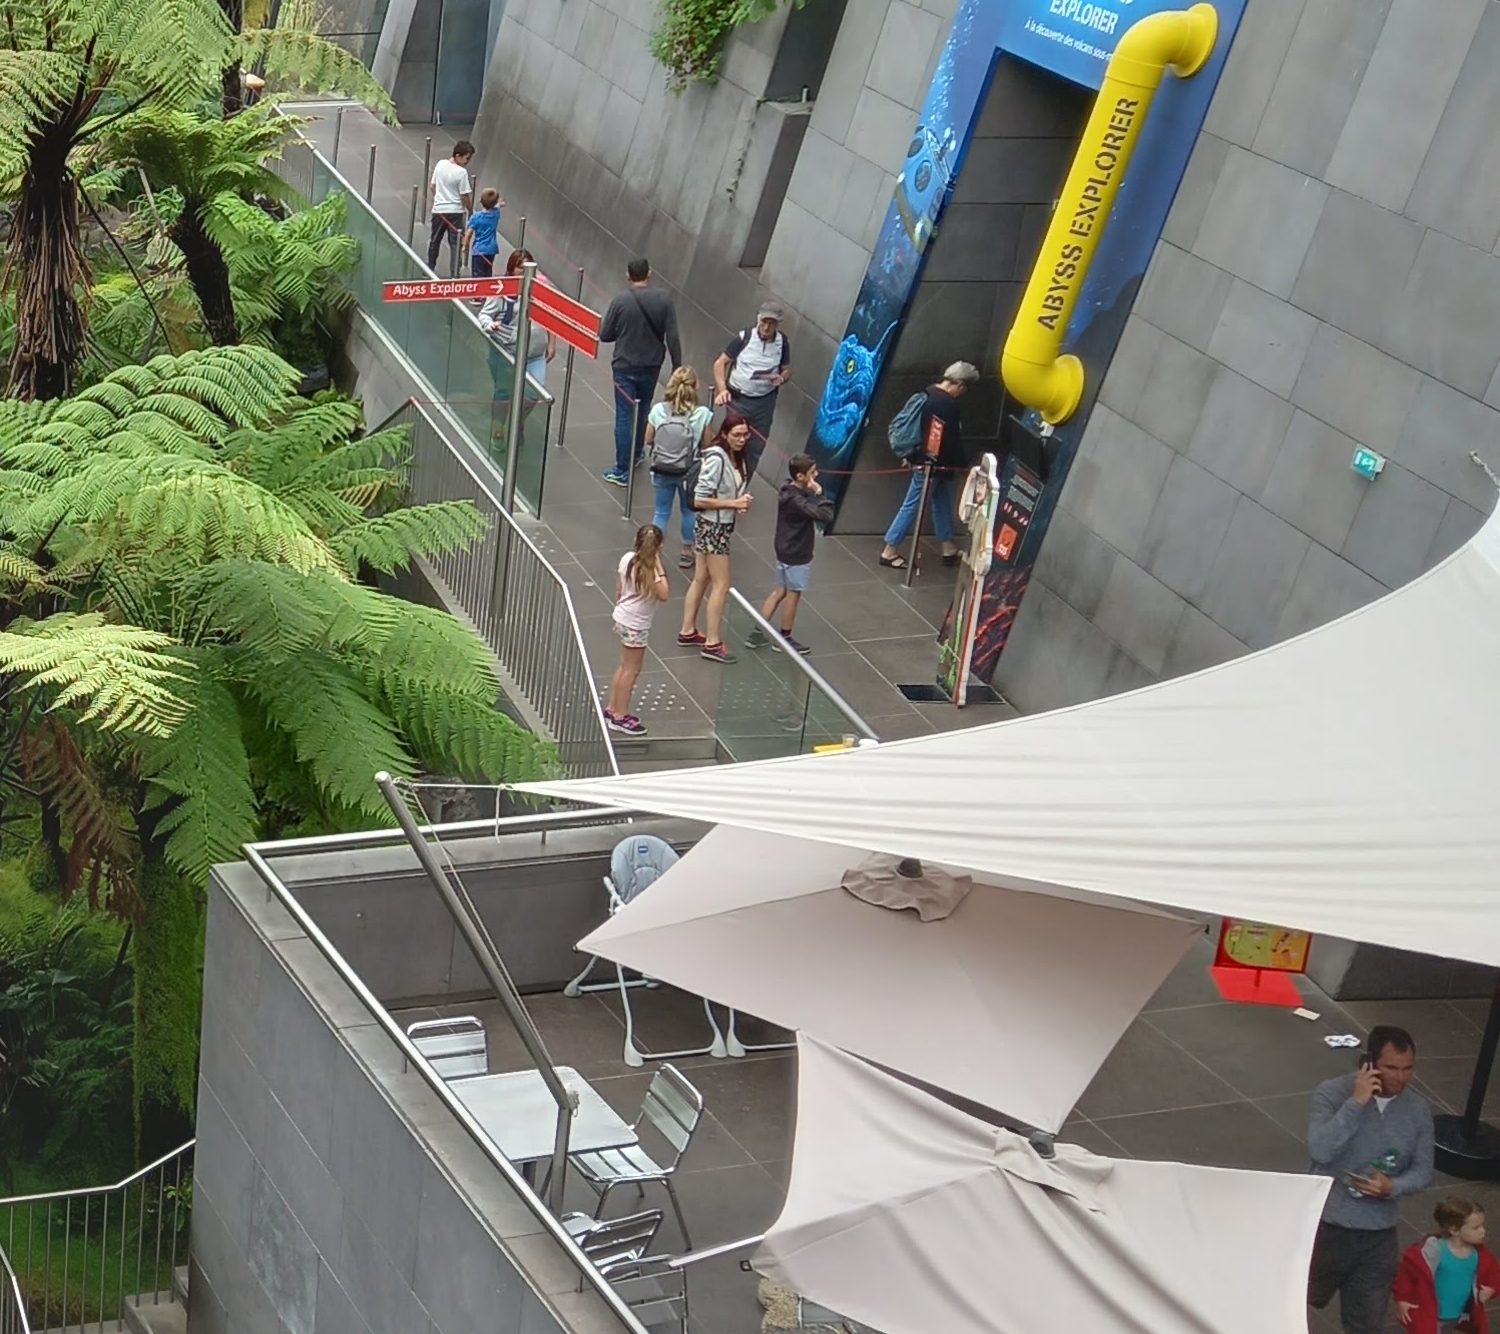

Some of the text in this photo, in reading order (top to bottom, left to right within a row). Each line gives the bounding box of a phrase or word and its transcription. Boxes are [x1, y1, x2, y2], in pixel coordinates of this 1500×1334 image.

[1063, 34, 1075, 47] des
[1073, 39, 1094, 55] volcans
[1037, 97, 1139, 331] ABYSS EXPLORER
[393, 282, 479, 297] Abyss Explorer
